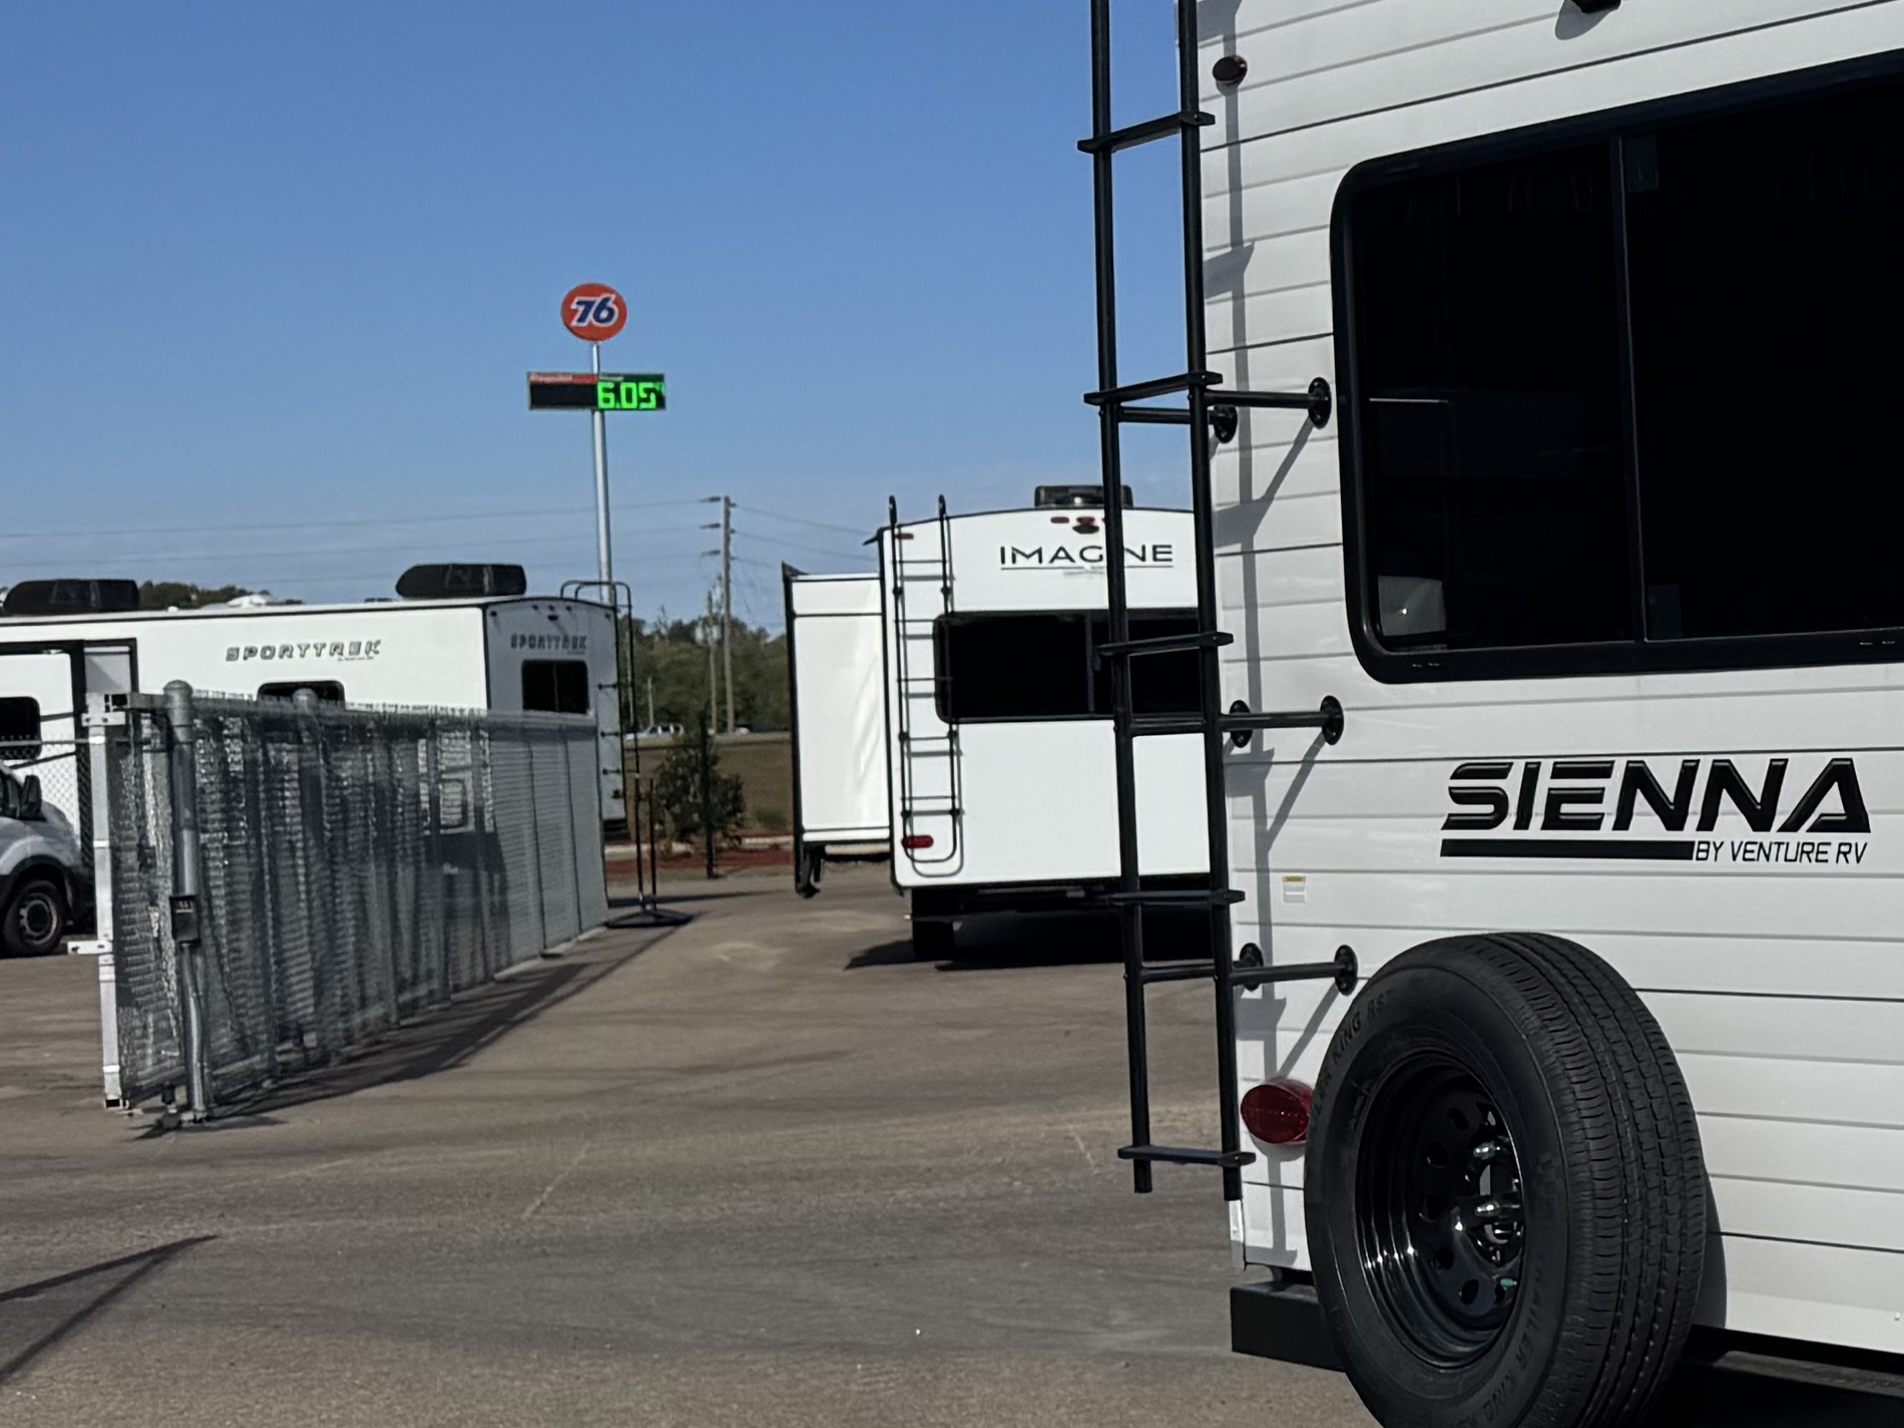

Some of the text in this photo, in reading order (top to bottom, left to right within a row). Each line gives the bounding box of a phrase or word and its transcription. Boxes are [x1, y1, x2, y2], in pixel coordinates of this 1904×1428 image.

[571, 294, 618, 327] 76
[1000, 544, 1173, 565] IMAGNE
[225, 639, 382, 662] SPORTTREK
[1440, 757, 1872, 834] SIENNA
[1695, 839, 1869, 865] BY VENTURE RV
